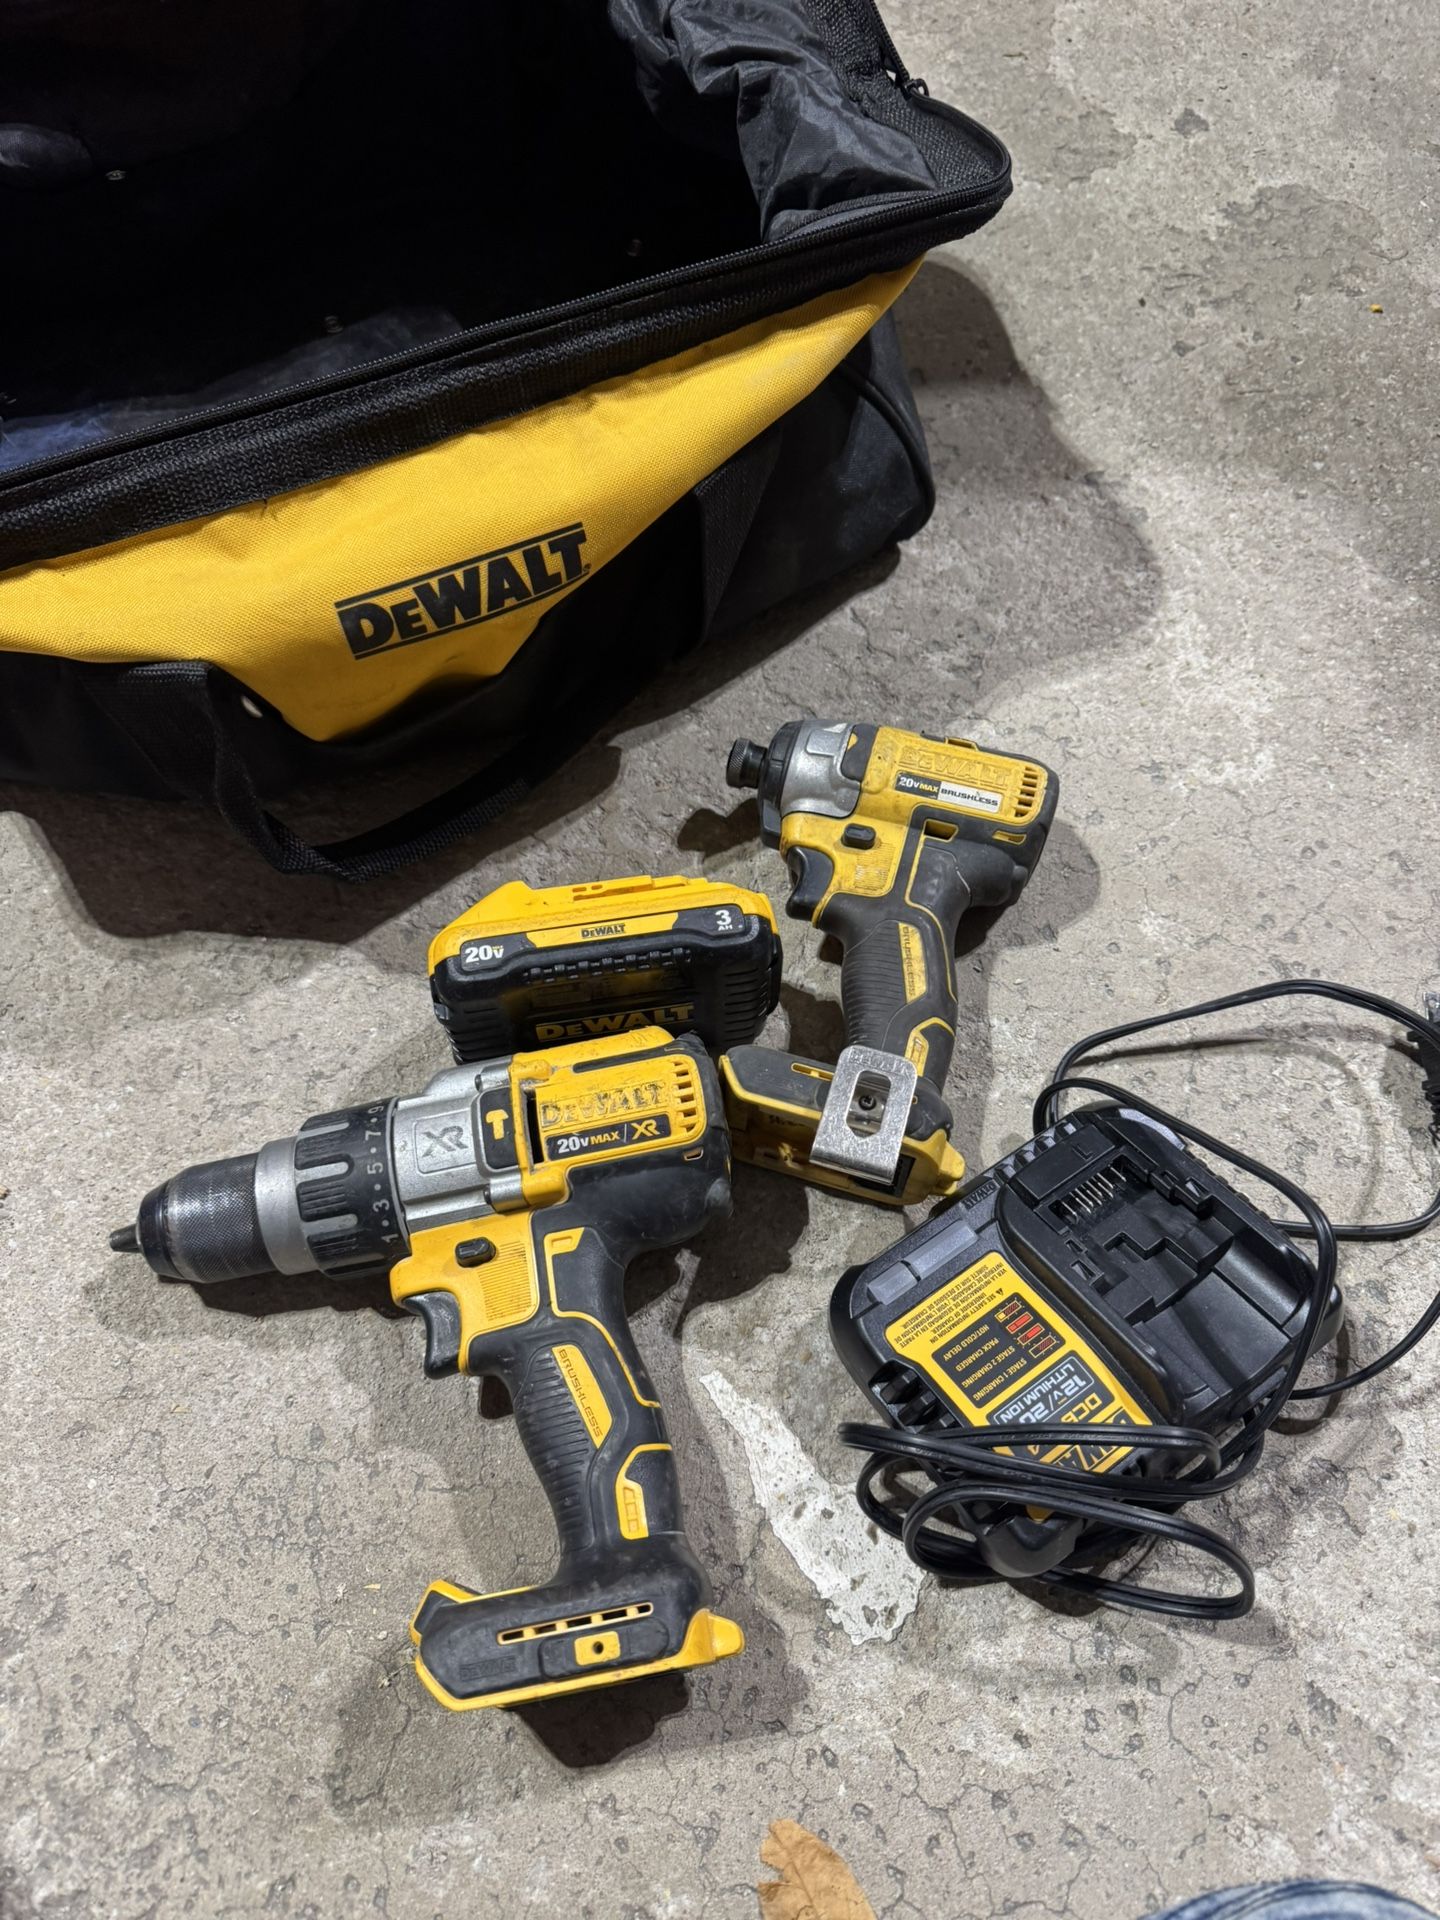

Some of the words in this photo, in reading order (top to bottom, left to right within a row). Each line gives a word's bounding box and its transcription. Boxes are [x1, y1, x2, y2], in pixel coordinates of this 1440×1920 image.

[941, 788, 998, 806] BRUSHLESS
[715, 909, 731, 925] 3
[365, 1130, 381, 1141] 7
[421, 1125, 469, 1157] XR
[591, 1131, 620, 1145] MAX
[631, 1119, 660, 1140] XR
[367, 1162, 383, 1174] 5
[373, 1199, 390, 1212] 3
[381, 1233, 399, 1243] 1
[968, 1299, 987, 1315] SAFETY
[937, 1311, 970, 1338] INFORMATION
[959, 1323, 989, 1348] HOT/COLD
[981, 1336, 999, 1352] PACK
[941, 1343, 962, 1361] DELAY
[954, 1348, 983, 1372] CHARGED
[995, 1345, 1015, 1362] STAGE
[961, 1361, 993, 1388] CHARGING
[1006, 1357, 1027, 1375] STAGE
[558, 1347, 604, 1439] BRUSHLESS
[972, 1374, 1004, 1400] CHARGING
[1022, 1363, 1074, 1405] LITHIUM
[999, 1400, 1024, 1422] ION
